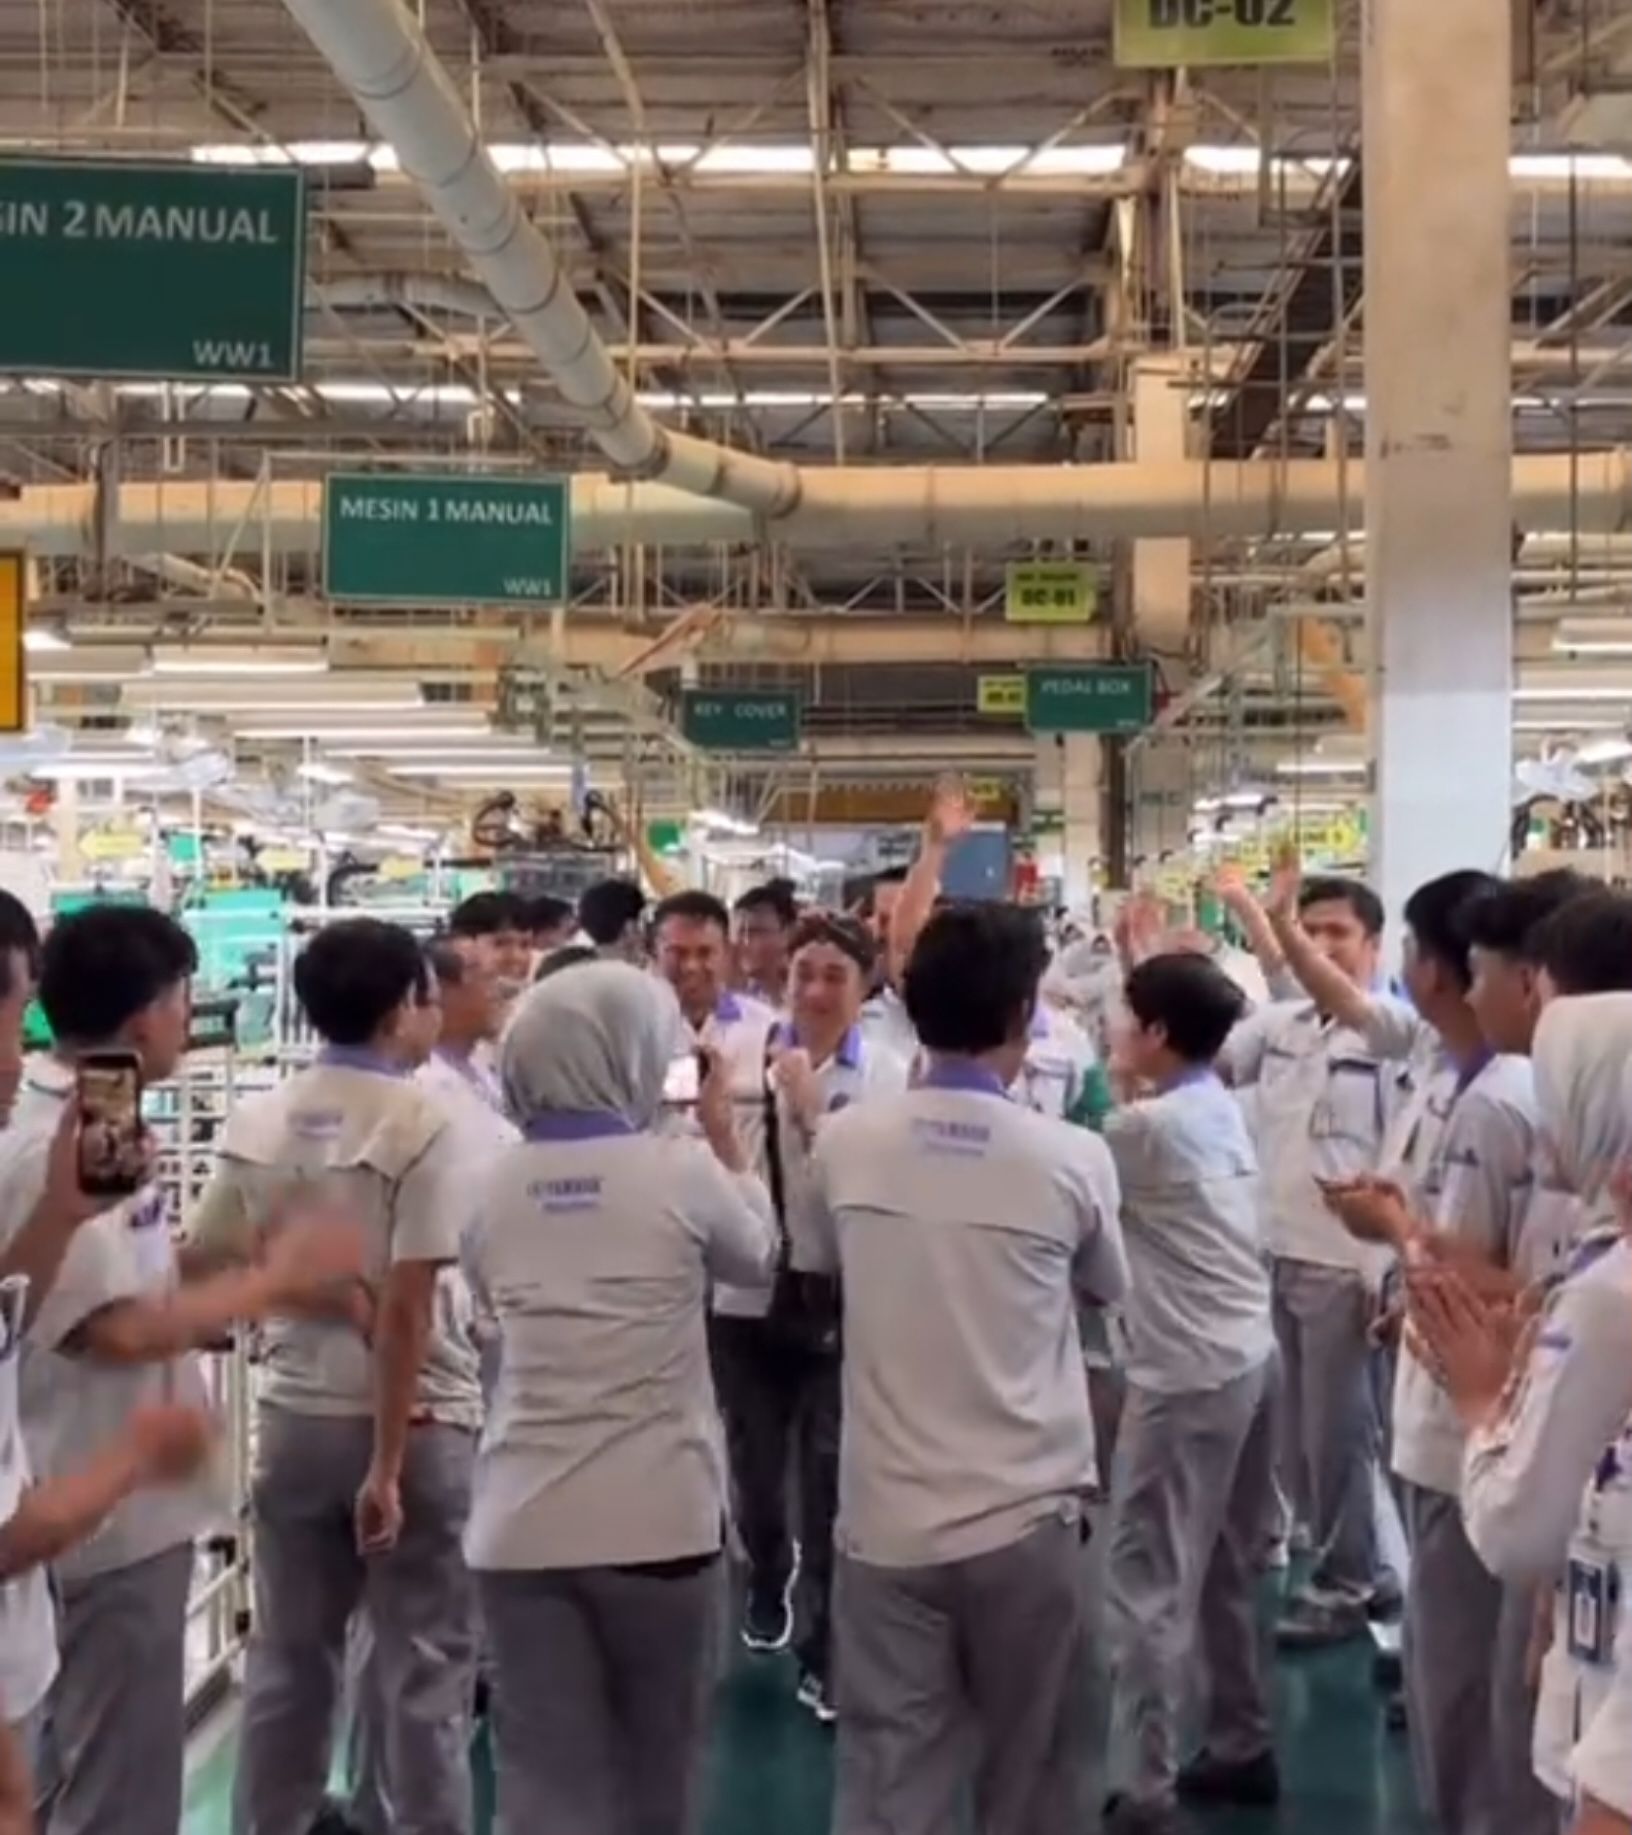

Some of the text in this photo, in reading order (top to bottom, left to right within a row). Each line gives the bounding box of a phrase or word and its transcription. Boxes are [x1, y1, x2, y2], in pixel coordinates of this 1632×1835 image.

[1149, 0, 1295, 29] DC-02
[0, 200, 278, 244] IN 2 MANUAL
[192, 339, 274, 367] WW1
[339, 497, 552, 525] MESIN 1 MANUAL
[503, 578, 552, 595] WW1
[1042, 680, 1132, 694] PEDAL BOX
